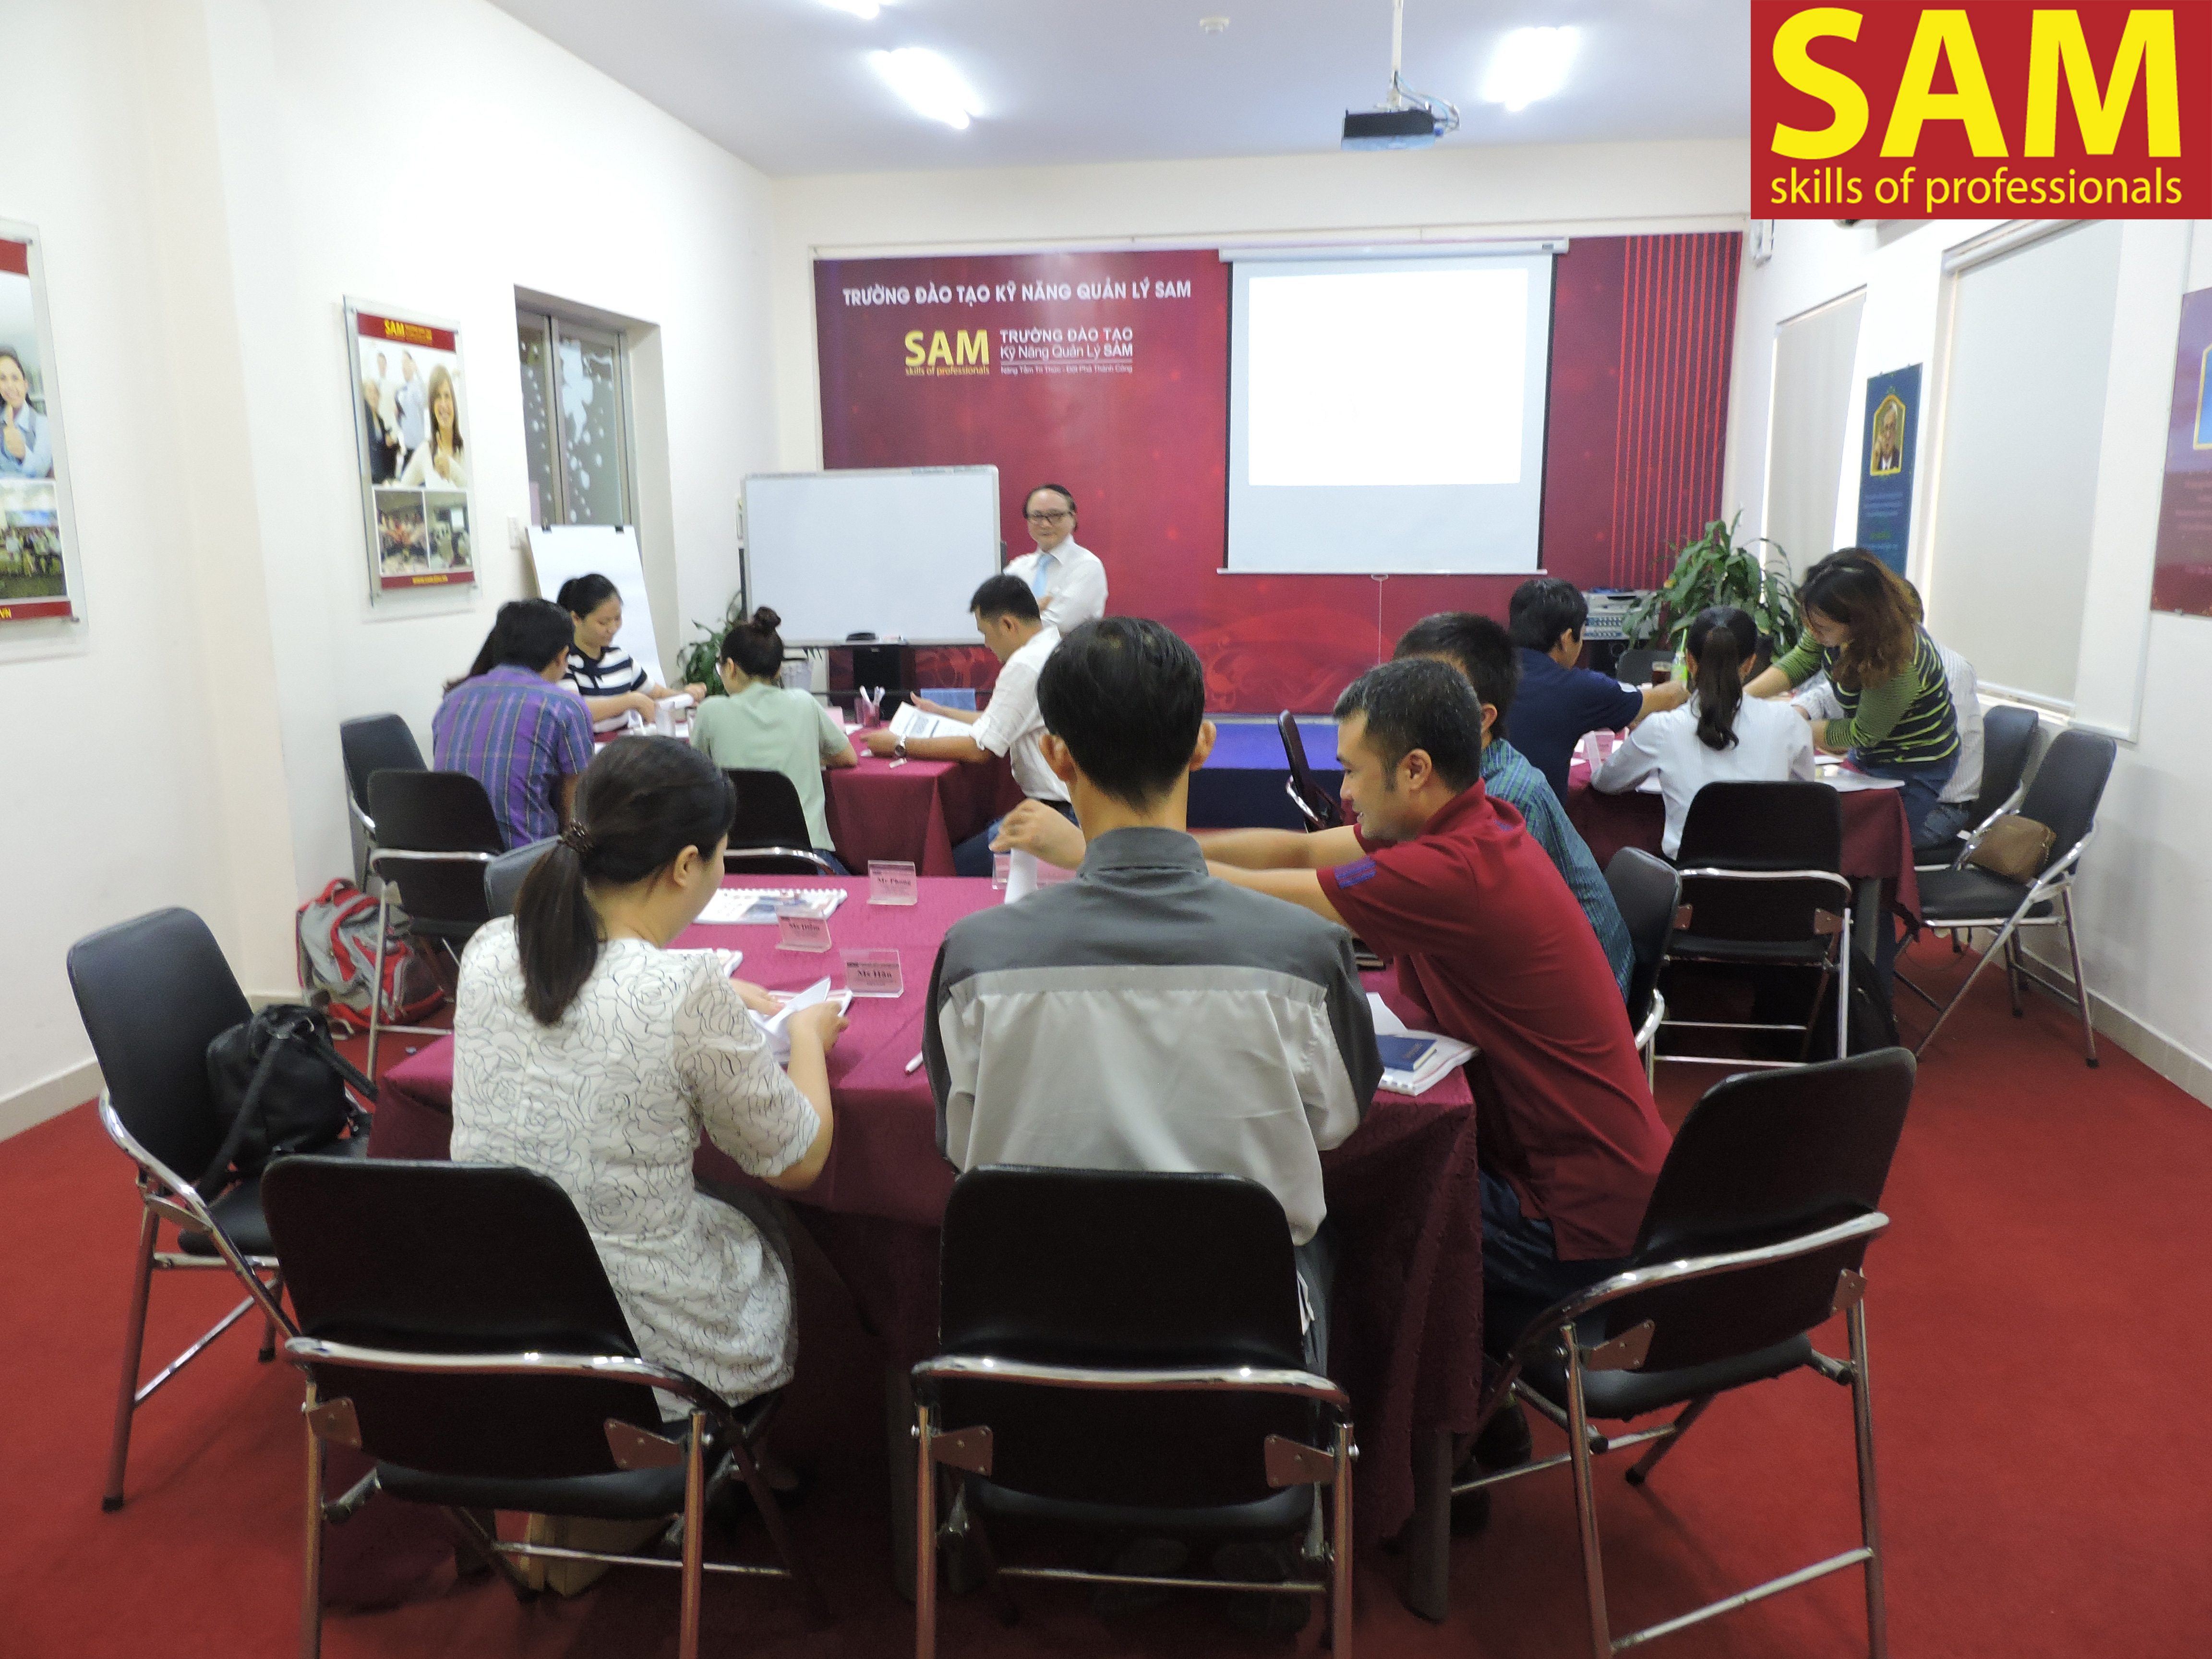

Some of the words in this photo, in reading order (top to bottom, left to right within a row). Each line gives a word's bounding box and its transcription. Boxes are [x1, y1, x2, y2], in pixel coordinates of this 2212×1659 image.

[842, 283, 910, 306] TRƯỜNG
[915, 280, 952, 304] ĐÀO
[956, 284, 990, 307] TẠO
[1022, 278, 1071, 301] NĂNG
[1132, 276, 1150, 300] LÝ
[1155, 280, 1191, 299] SAM
[385, 319, 405, 337] SAM
[1000, 326, 1063, 343] TRƯỜNG
[904, 329, 989, 367] SAM
[1104, 342, 1133, 357] SAM
